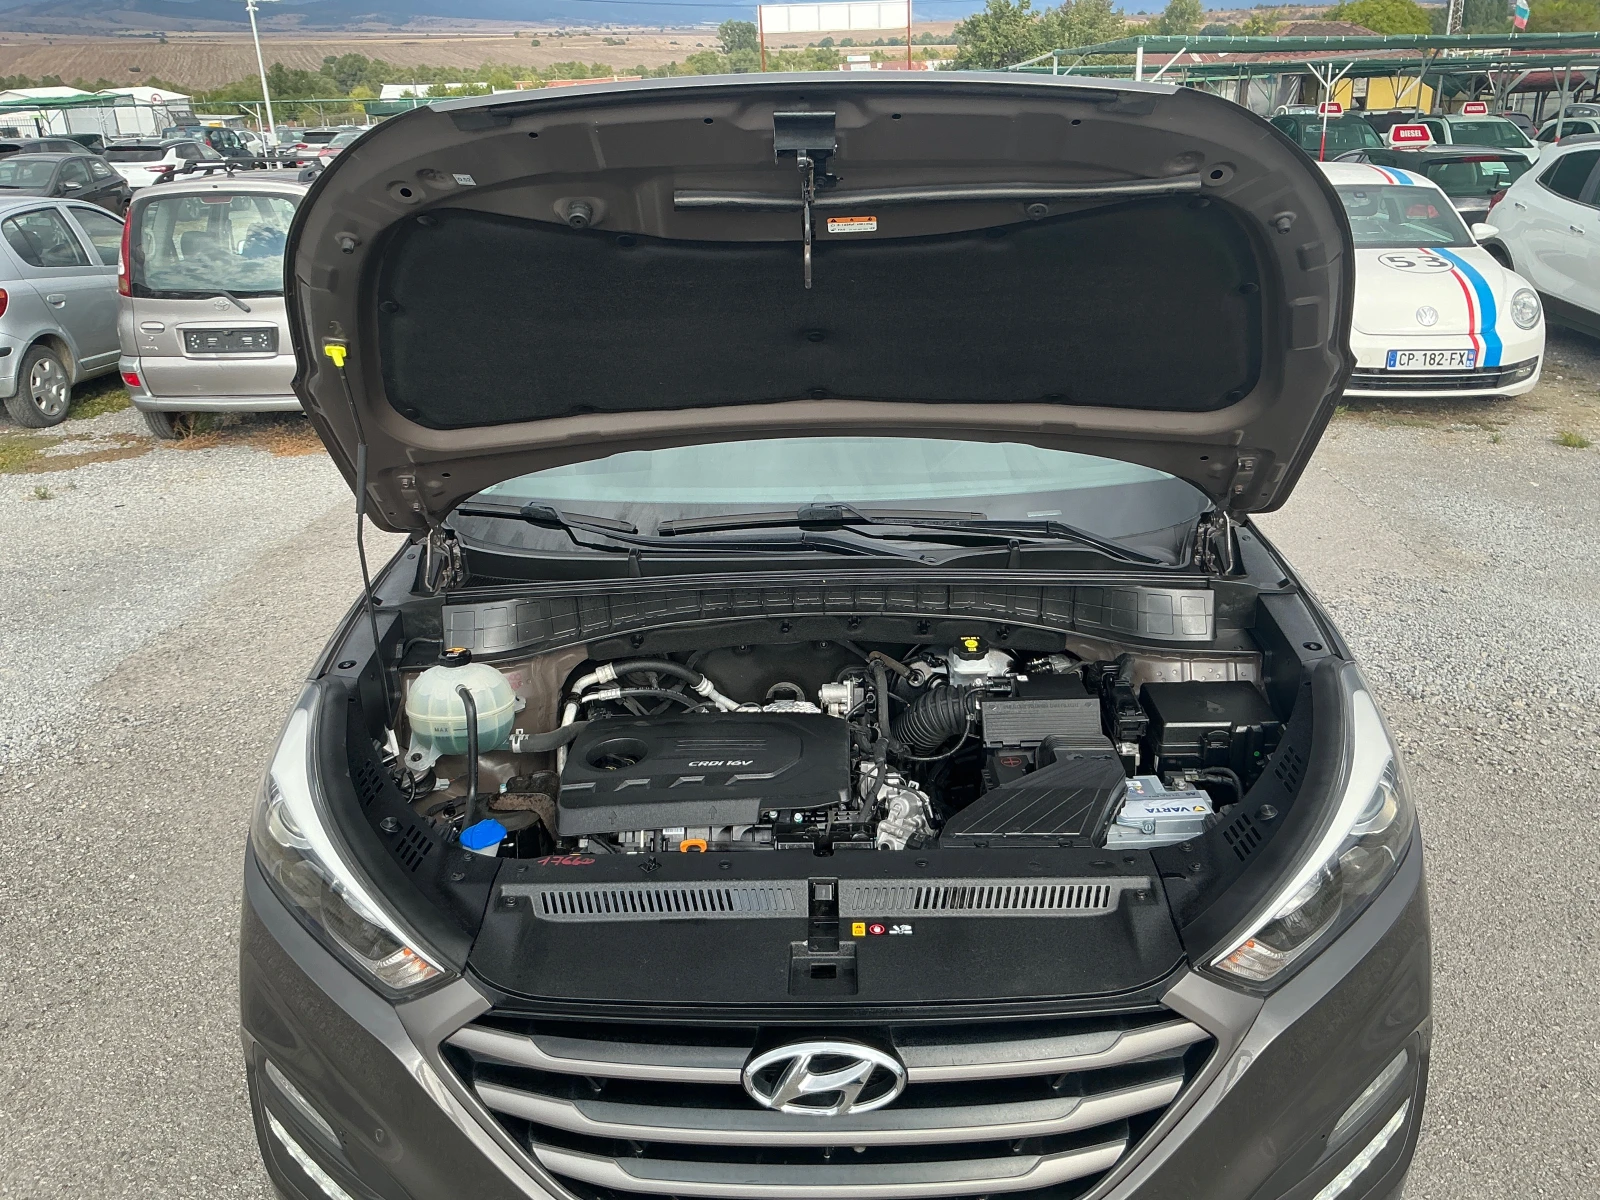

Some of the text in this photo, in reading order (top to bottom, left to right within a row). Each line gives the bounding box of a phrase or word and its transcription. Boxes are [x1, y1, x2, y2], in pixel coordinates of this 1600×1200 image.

[1400, 130, 1423, 138] DIESEL
[1385, 255, 1449, 268] 53
[1399, 352, 1466, 366] CP-182-FX
[1145, 806, 1191, 814] VARTA
